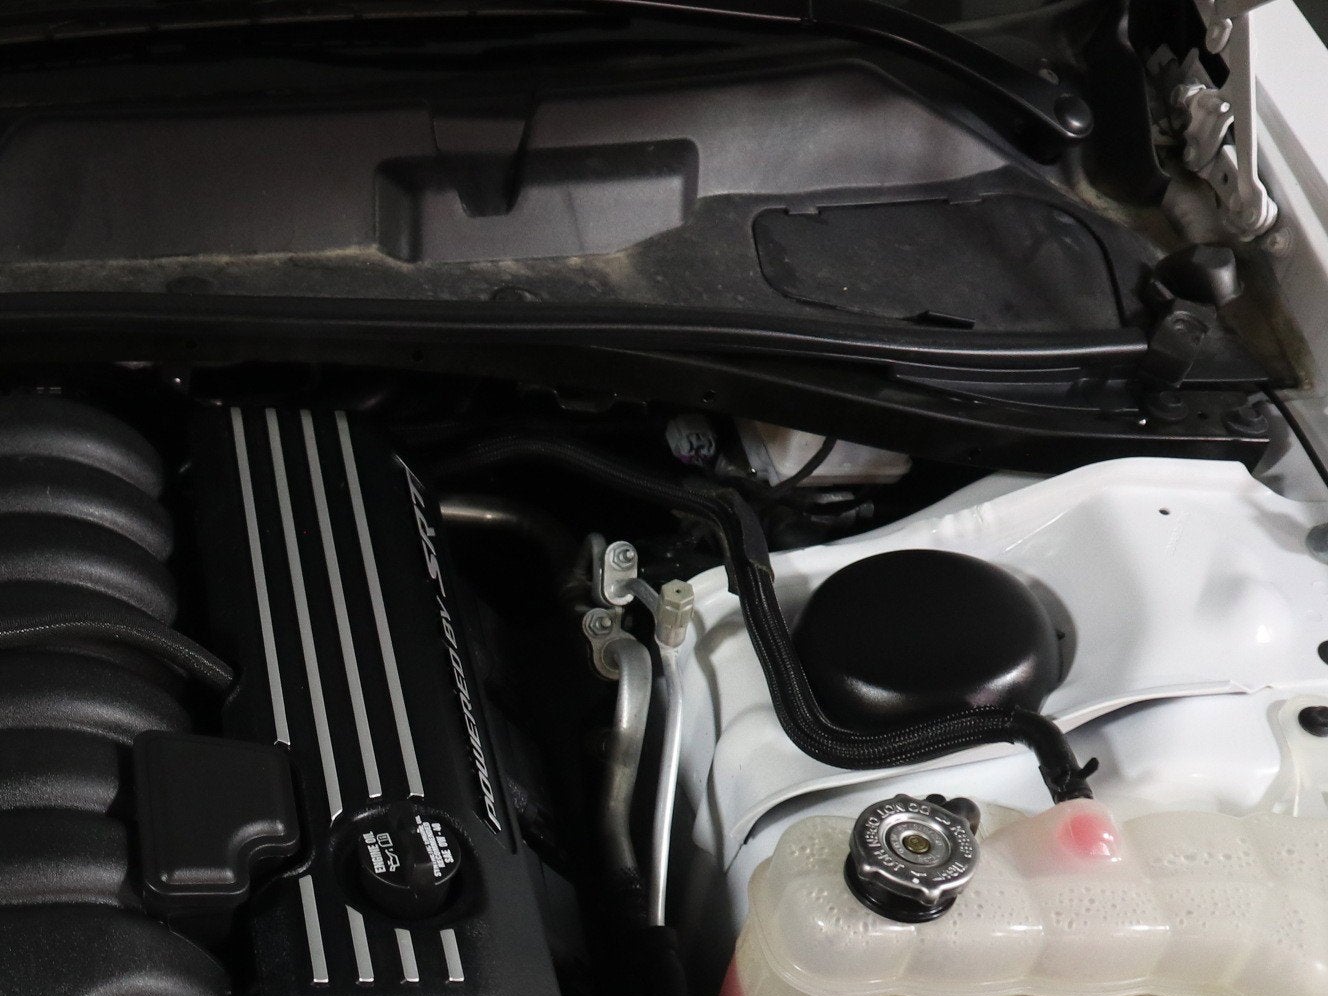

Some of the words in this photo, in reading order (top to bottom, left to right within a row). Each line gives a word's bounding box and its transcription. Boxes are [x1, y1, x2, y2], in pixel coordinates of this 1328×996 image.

[404, 465, 445, 597] SRT
[437, 596, 458, 649] BY
[448, 646, 501, 830] POWERED
[877, 802, 906, 819] NOT
[908, 803, 931, 816] DO
[363, 831, 376, 844] OIL
[865, 816, 882, 848] OPEN
[367, 844, 386, 873] ENGINE
[441, 849, 454, 863] SAE
[873, 849, 905, 872] HOT
